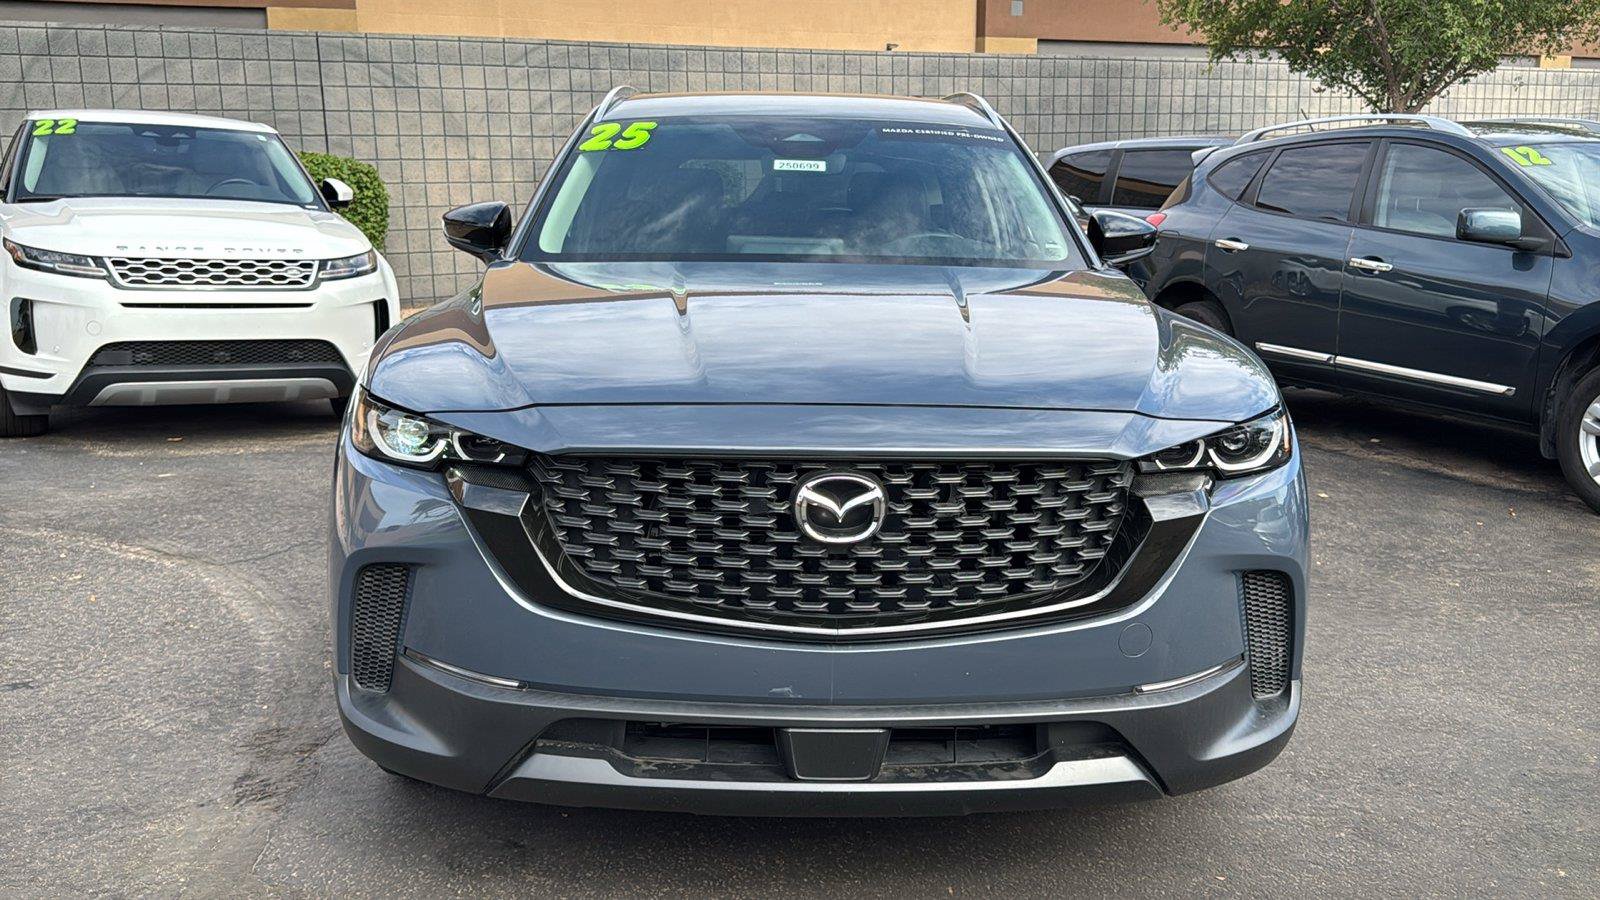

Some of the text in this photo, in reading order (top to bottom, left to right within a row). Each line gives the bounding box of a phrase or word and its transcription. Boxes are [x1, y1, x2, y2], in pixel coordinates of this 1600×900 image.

[32, 119, 78, 136] 22
[578, 121, 658, 152] 25
[915, 129, 955, 137] CERTIFIED
[1500, 145, 1553, 167] 12
